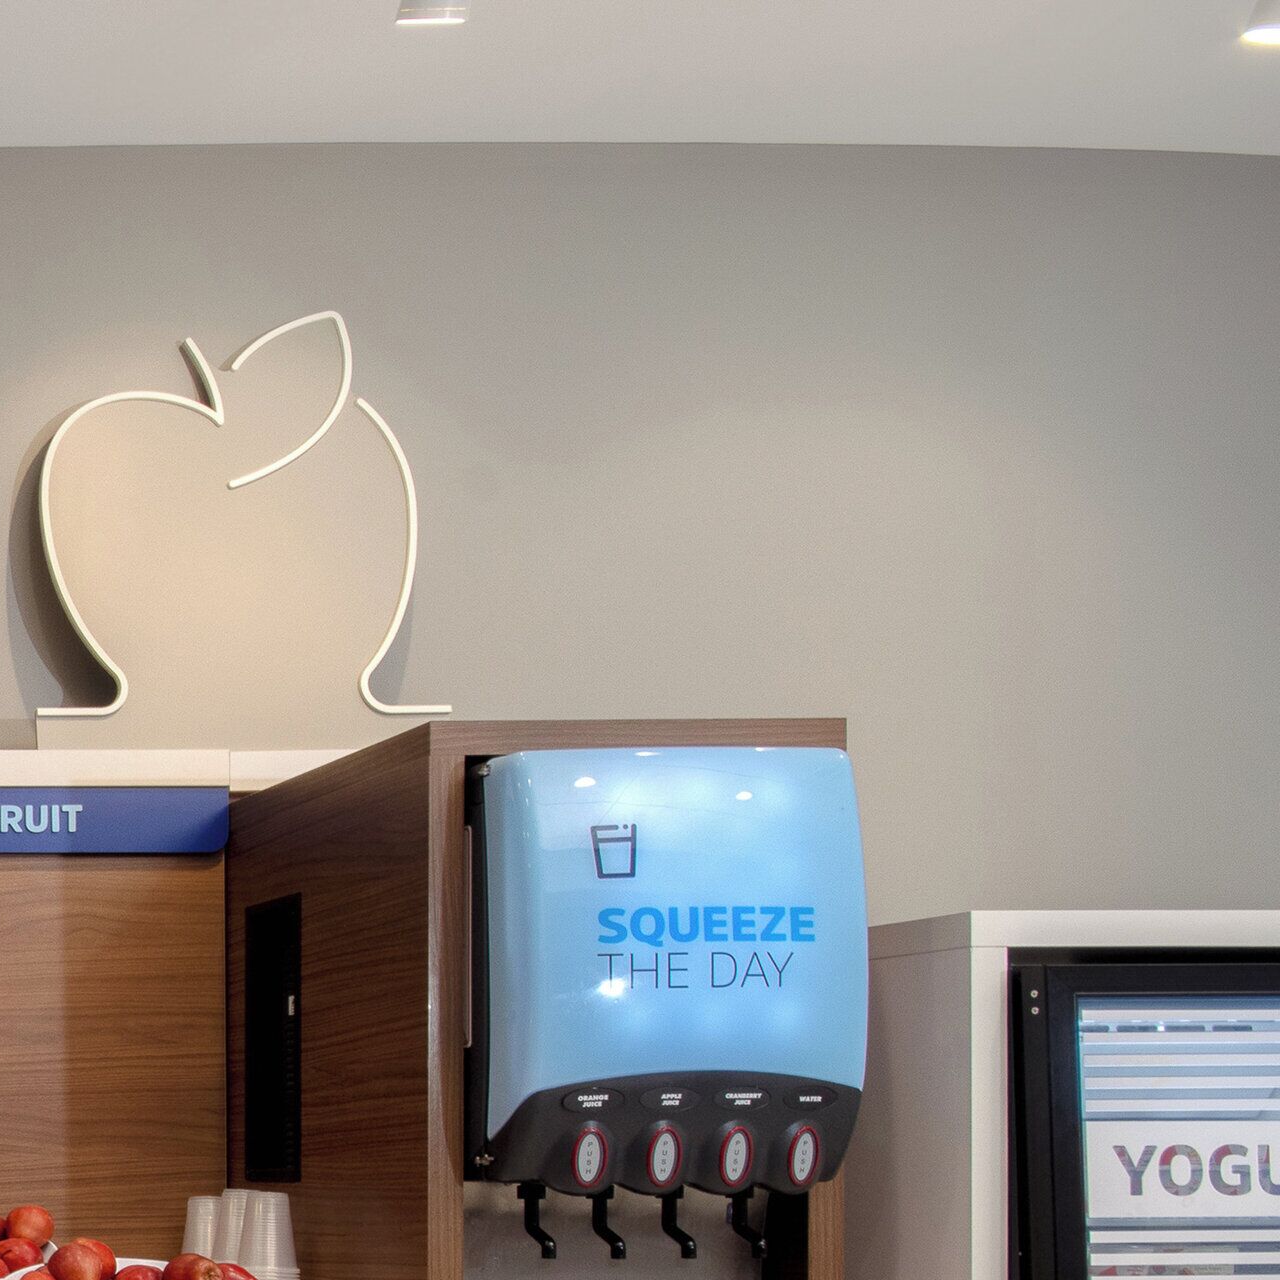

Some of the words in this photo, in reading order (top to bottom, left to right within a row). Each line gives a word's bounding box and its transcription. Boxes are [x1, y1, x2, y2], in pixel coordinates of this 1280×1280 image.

[597, 906, 816, 947] SQUEEZE
[597, 952, 689, 989] THE
[711, 951, 794, 988] DAY
[577, 1094, 609, 1102] ORANGE
[585, 1141, 594, 1175] PUSH
[660, 1140, 669, 1174] PUSH
[731, 1140, 741, 1174] PUSH
[799, 1140, 809, 1173] PUSH
